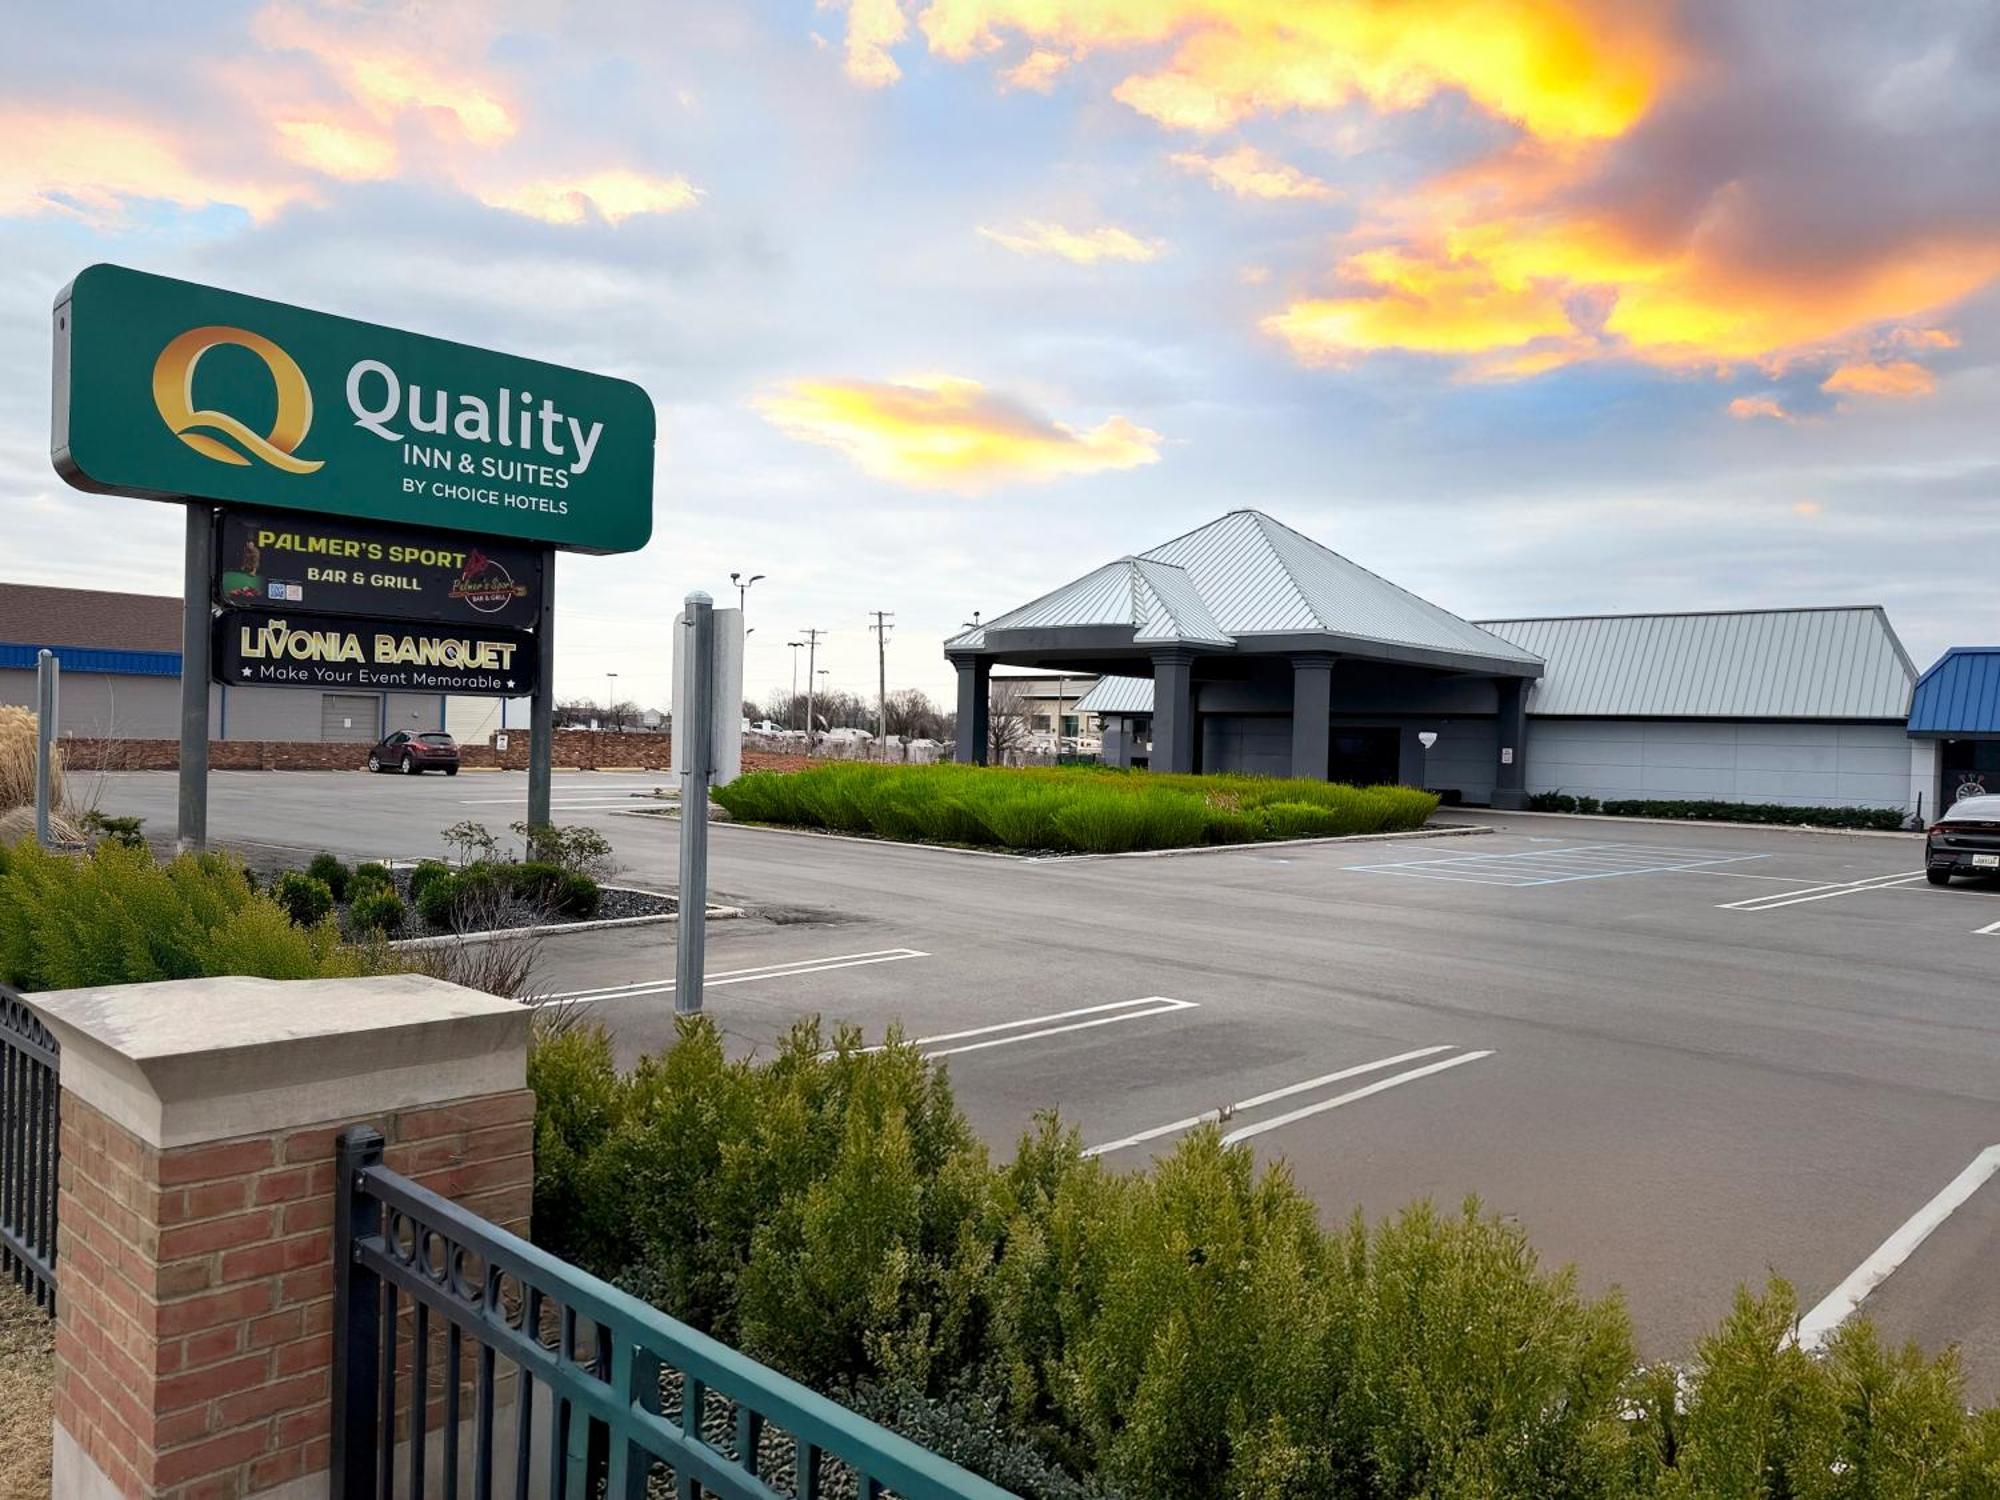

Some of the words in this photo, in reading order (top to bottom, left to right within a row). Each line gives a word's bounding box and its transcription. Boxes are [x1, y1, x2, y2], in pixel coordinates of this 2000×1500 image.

[346, 359, 604, 474] Quality
[404, 444, 451, 470] INN
[458, 453, 475, 474] &
[481, 457, 569, 489] SUITES
[402, 478, 426, 494] BY
[432, 483, 499, 505] CHOICE
[504, 493, 568, 514] HOTELS
[258, 531, 382, 560] PALMER'S
[389, 547, 466, 568] SPORT
[308, 567, 346, 583] BAR
[352, 571, 365, 585] &
[370, 573, 423, 591] GRILL
[241, 626, 365, 664] LIVONIA
[374, 634, 517, 671] BANQUET
[260, 665, 309, 681] Make
[314, 667, 352, 682] Your
[359, 669, 406, 685] Event
[413, 673, 501, 689] Memorable
